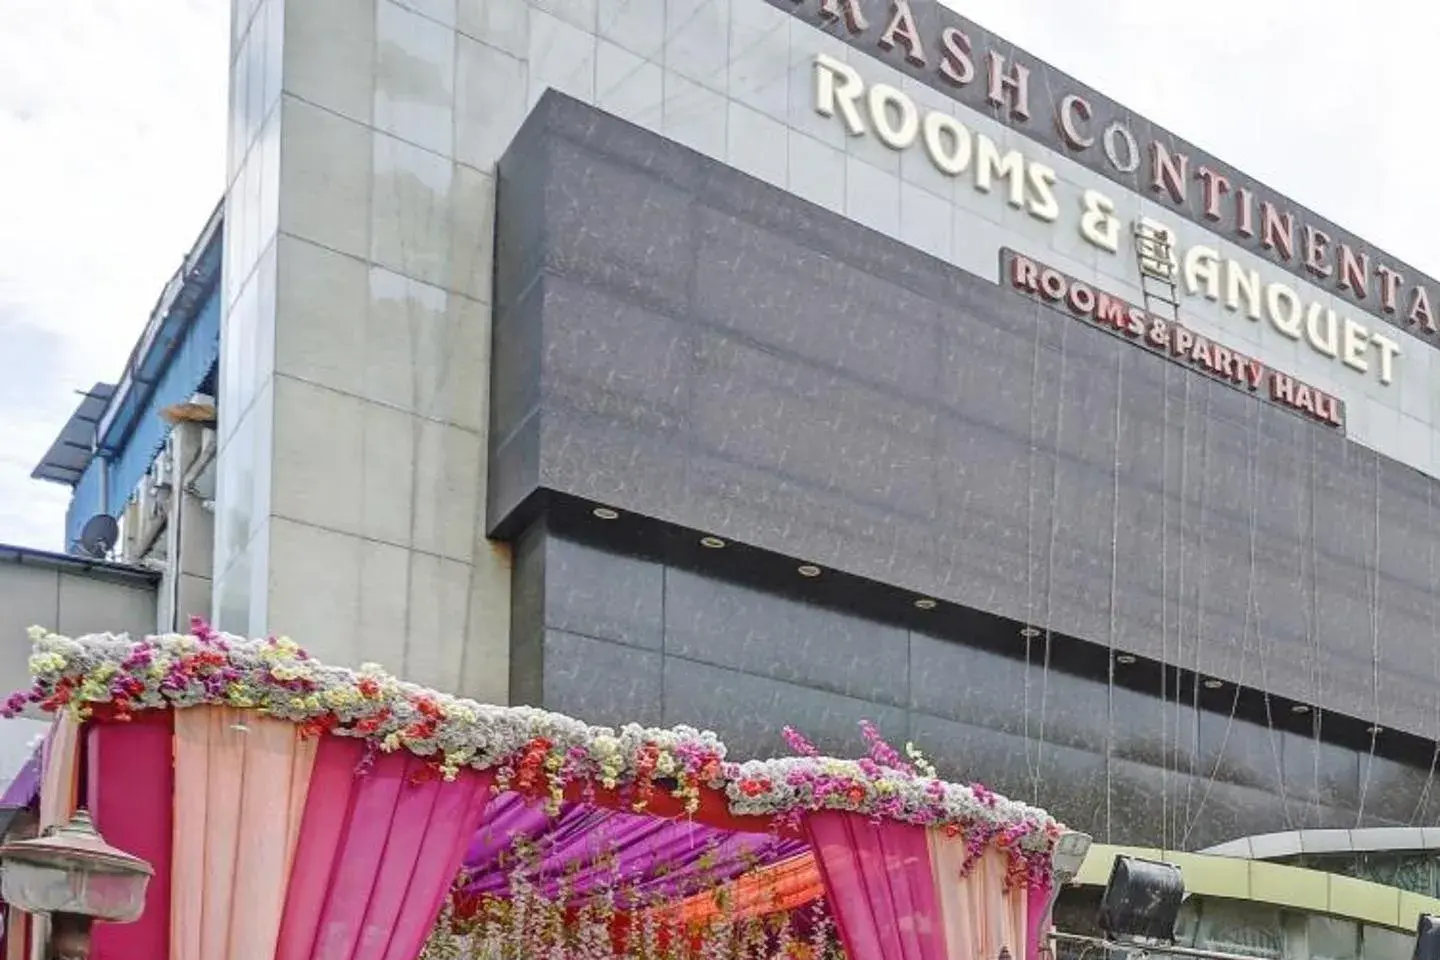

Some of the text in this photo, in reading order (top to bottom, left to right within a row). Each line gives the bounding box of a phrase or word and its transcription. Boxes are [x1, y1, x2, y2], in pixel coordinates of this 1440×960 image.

[813, 53, 1400, 386] ROOMS & BANQUET
[1012, 256, 1342, 427] ROOMS & PARTY HALL
